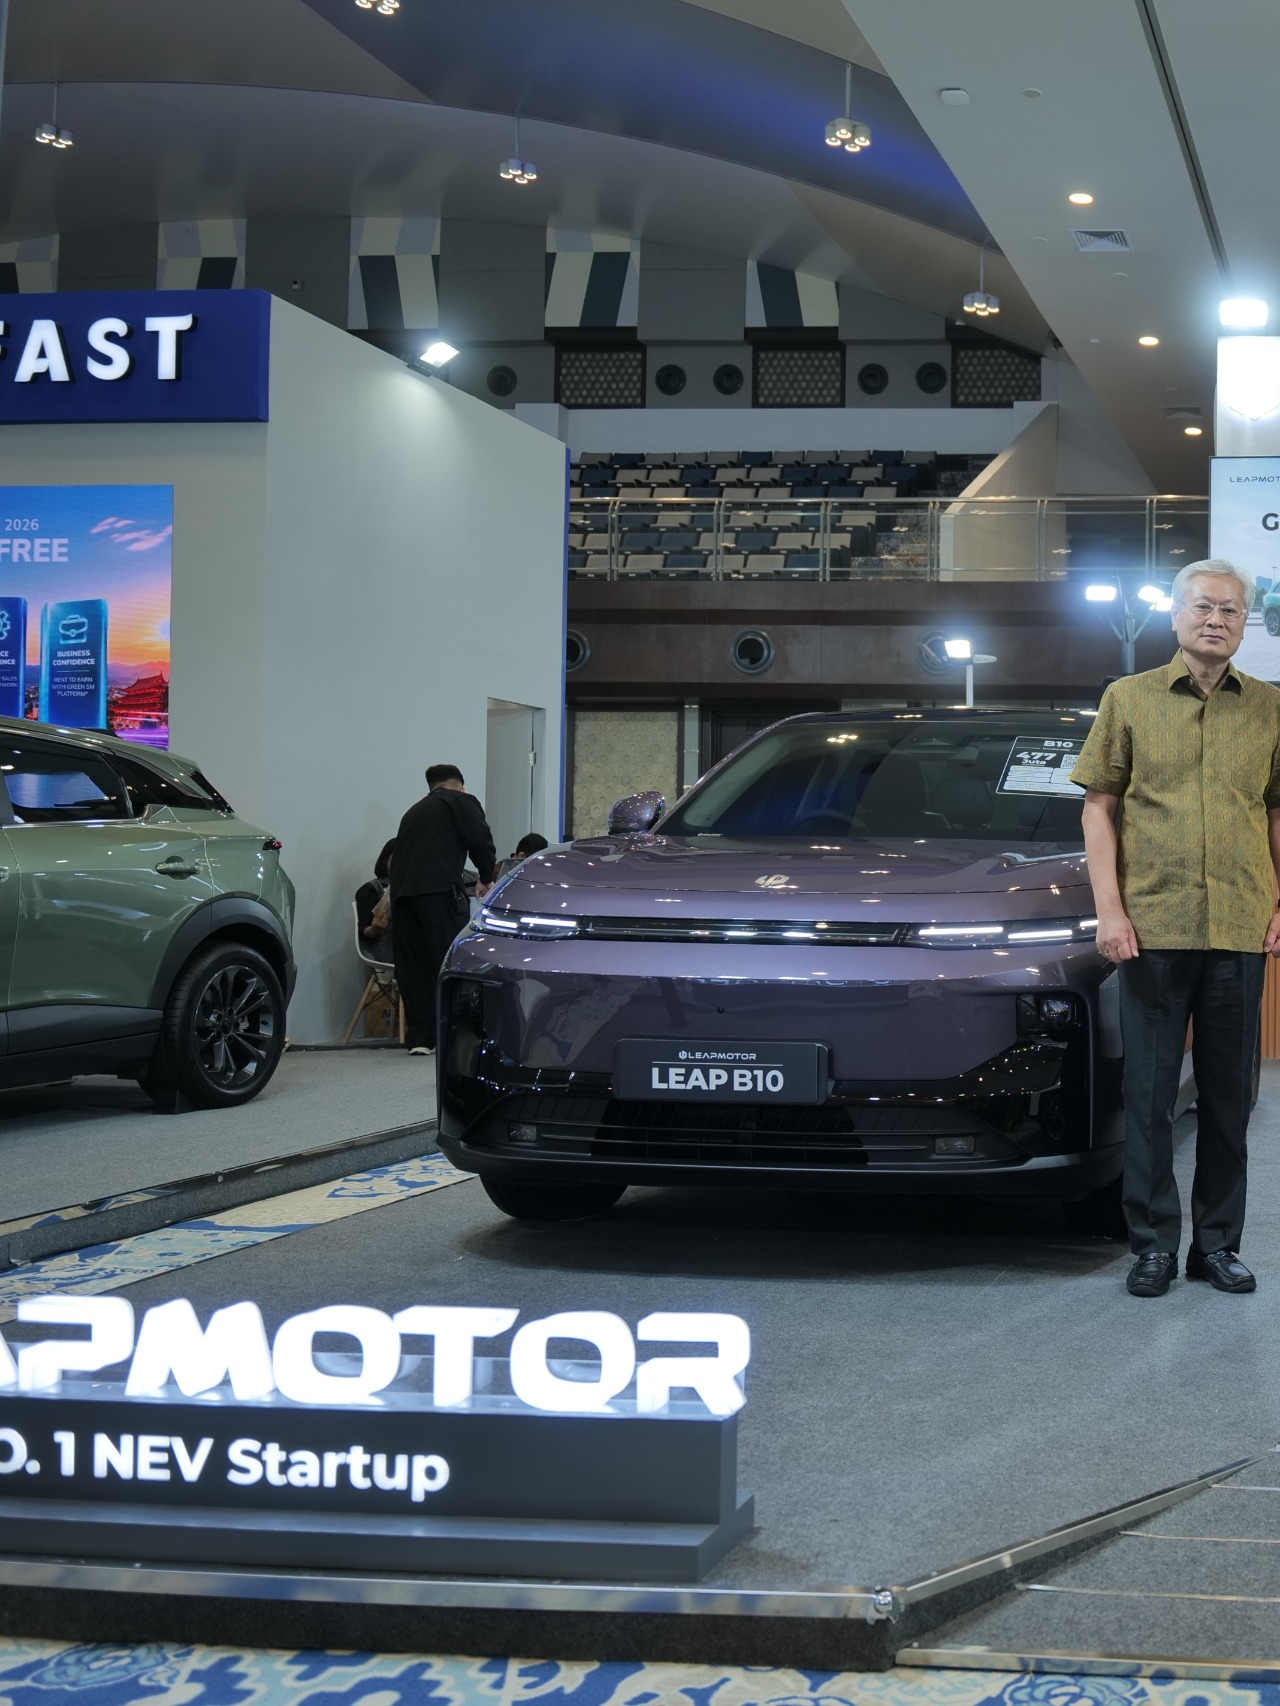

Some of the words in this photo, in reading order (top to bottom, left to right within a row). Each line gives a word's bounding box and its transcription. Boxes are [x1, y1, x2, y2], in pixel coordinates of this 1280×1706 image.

[0, 313, 193, 382] AST
[4, 518, 39, 531] 2026
[0, 538, 69, 562] FREE
[52, 658, 95, 666] CONFIDENCE
[1043, 740, 1073, 748] B10
[1016, 752, 1057, 761] 477
[688, 1052, 757, 1060] LEAPMOTOR
[652, 1067, 728, 1090] LEAP
[733, 1069, 784, 1092] B10
[0, 1294, 751, 1414] PMOTOR
[54, 1431, 75, 1477] 1
[93, 1432, 214, 1482] NEV
[226, 1438, 450, 1502] Startup
